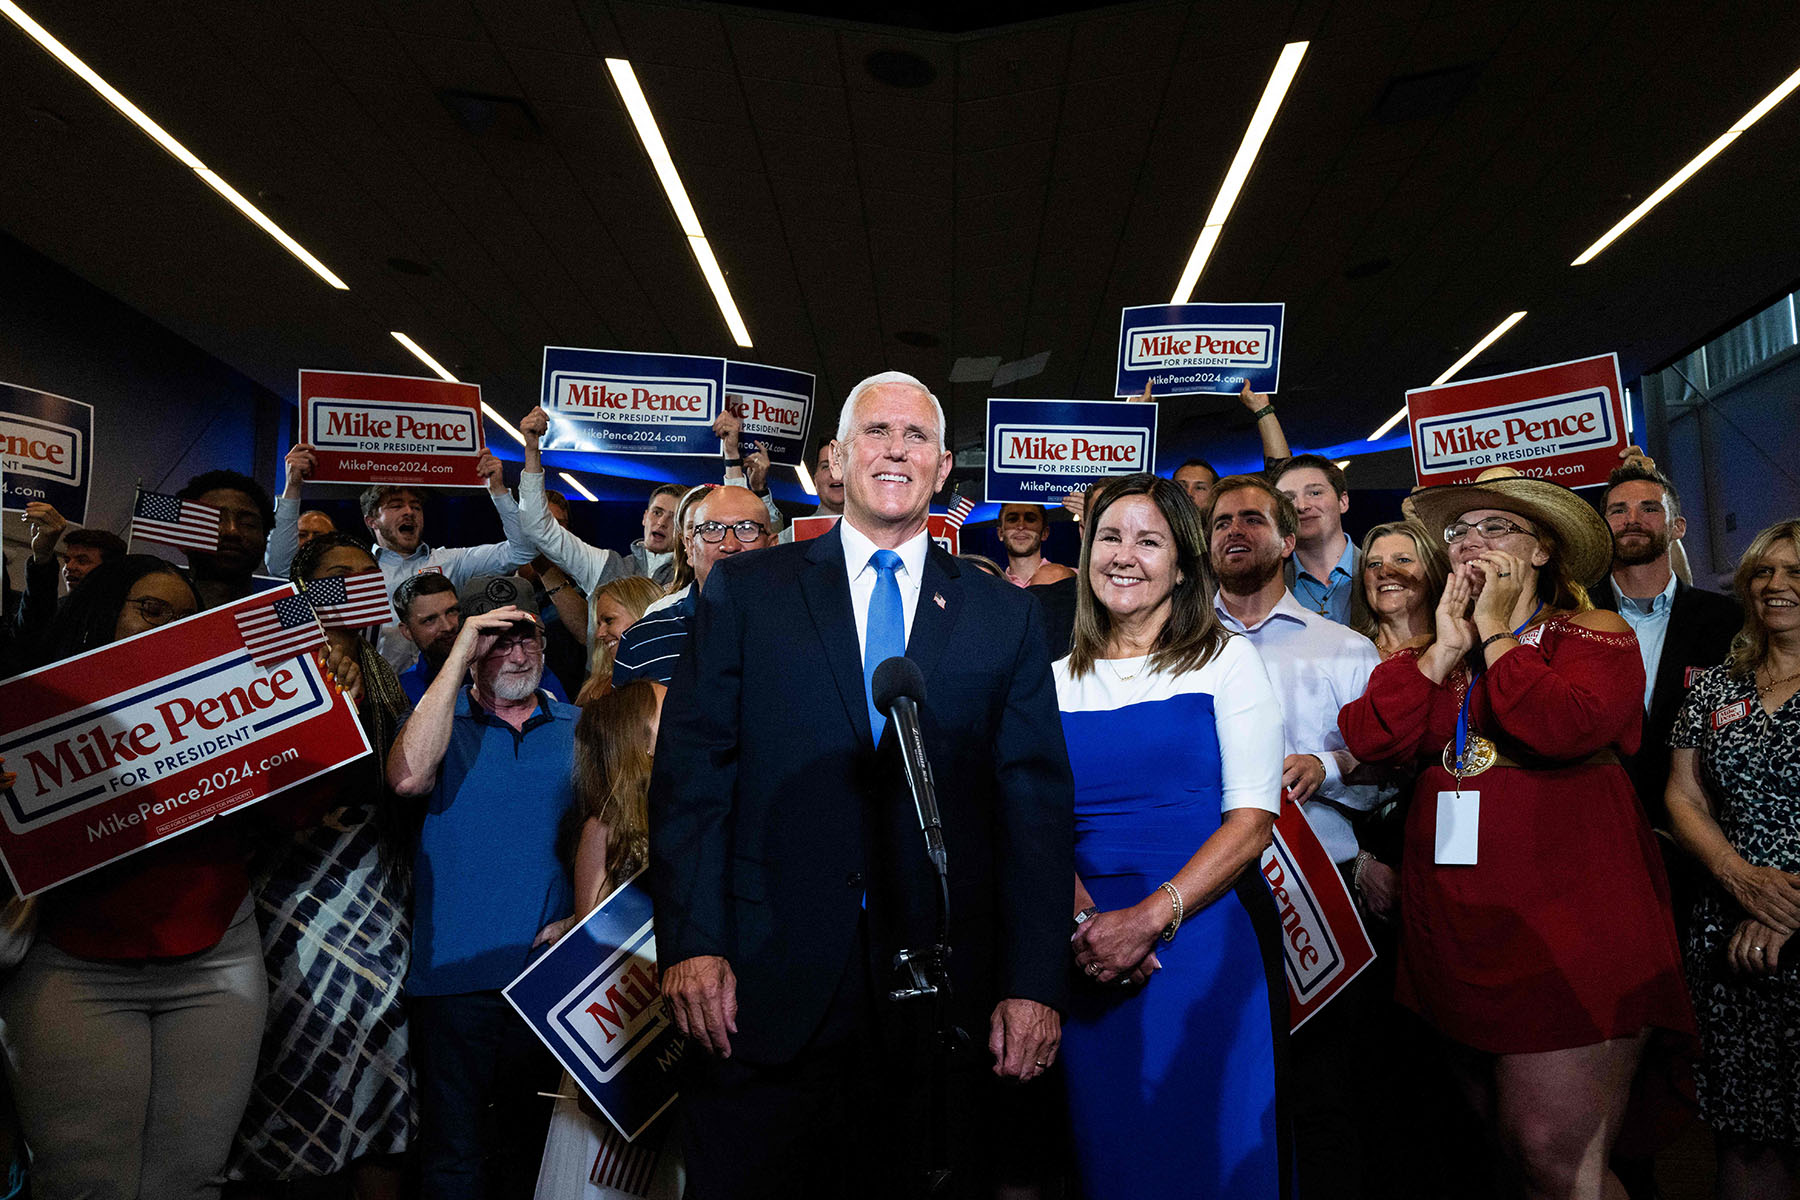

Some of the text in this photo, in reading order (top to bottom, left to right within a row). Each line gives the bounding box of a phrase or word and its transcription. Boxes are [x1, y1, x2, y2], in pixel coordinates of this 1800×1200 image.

[1138, 334, 1260, 357] Mike Pence
[1183, 358, 1229, 366] PRESIDENT
[1148, 373, 1244, 385] MikePence2024.com
[565, 383, 702, 412] Mike Pence
[596, 412, 669, 422] FOR PRESIDENT
[752, 399, 799, 426] Pence
[326, 411, 466, 441] Mike Pence
[576, 427, 686, 443] ikePence2024.com
[741, 423, 779, 433] PRESIDENT
[1432, 411, 1596, 457] Mike Pence
[360, 442, 435, 452] FOR PRESIDENT
[1009, 437, 1136, 462] Mike Pence
[1469, 444, 1557, 466] FOR PRESIDENT
[339, 459, 453, 473] MikePence2024.com
[1038, 464, 1107, 474] FOR PRESIDENT
[23, 668, 298, 797] Mike Pence
[109, 725, 252, 793] FOR PRESIDENT
[87, 746, 300, 843] MikePence2024.com
